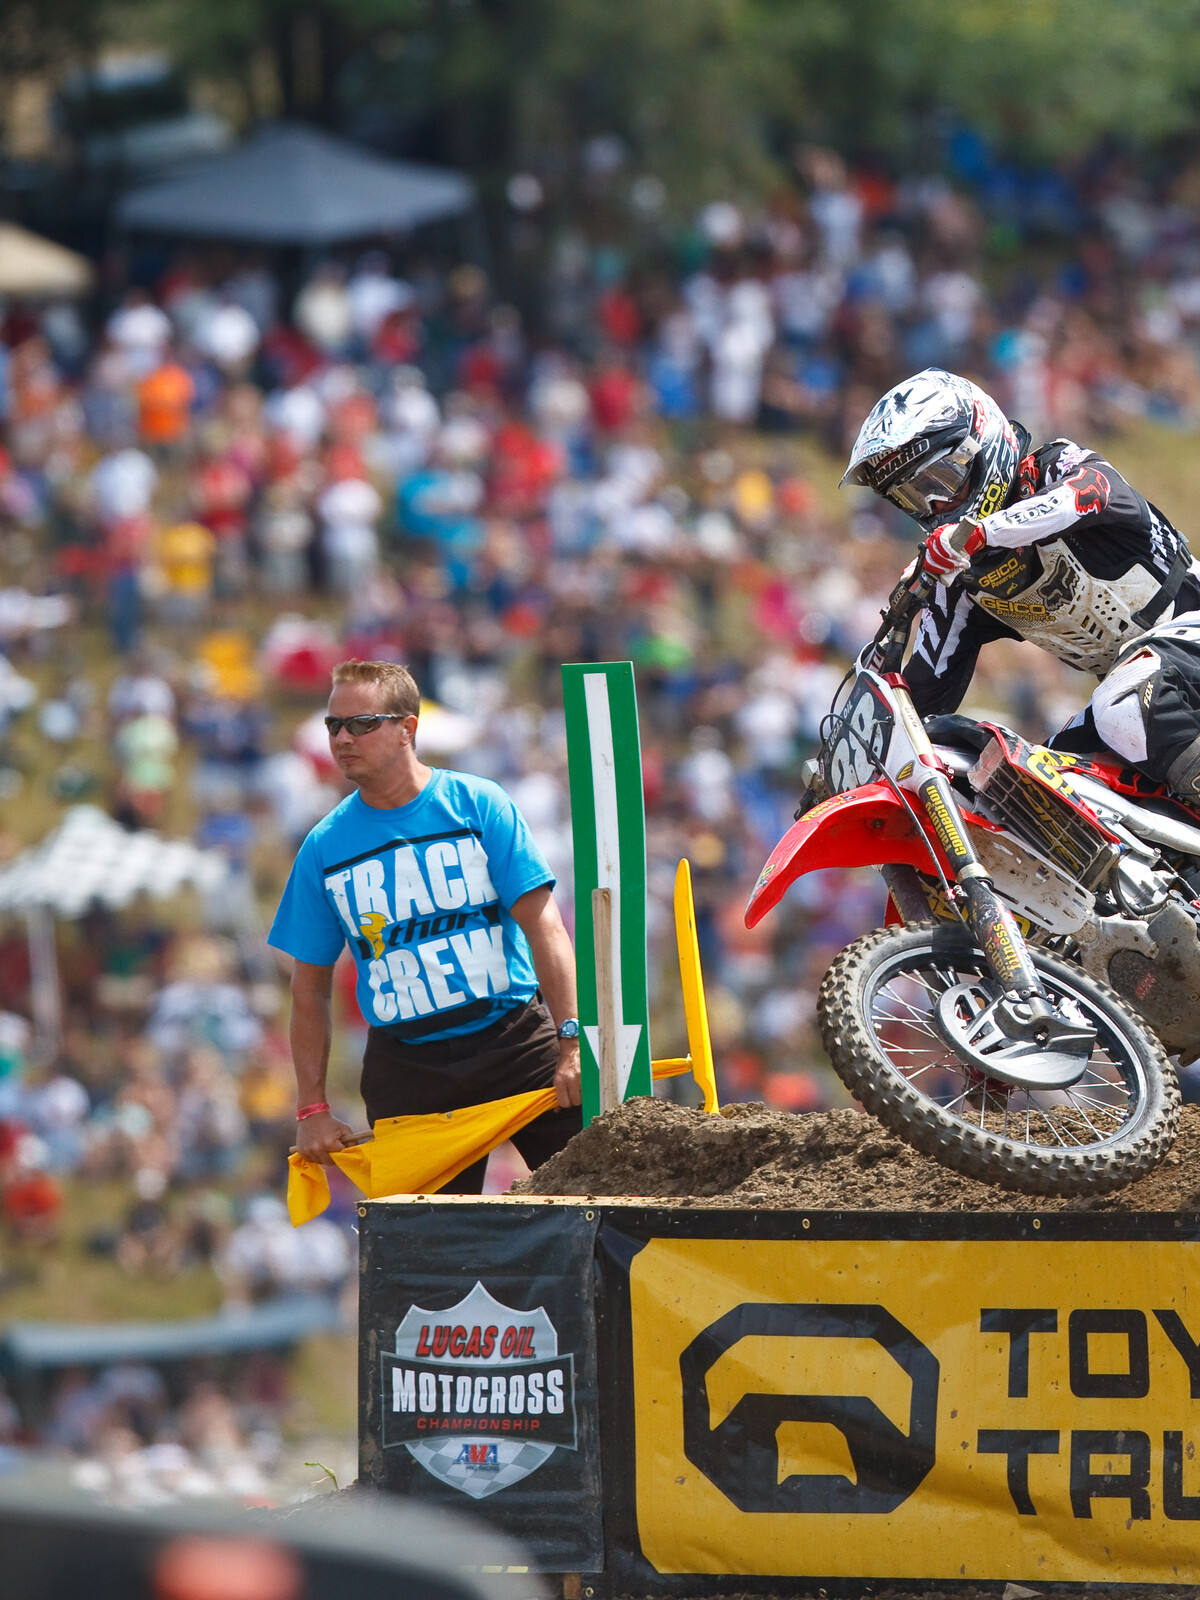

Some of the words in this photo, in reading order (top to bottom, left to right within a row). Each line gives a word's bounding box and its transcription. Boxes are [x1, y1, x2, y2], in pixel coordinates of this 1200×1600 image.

[978, 557, 1018, 588] GEICO
[991, 563, 1026, 589] Powersports
[981, 597, 1046, 615] GEICO
[1143, 681, 1153, 708] FOX
[324, 837, 499, 938] TRACK
[388, 911, 480, 946] thor
[368, 925, 511, 1022] CREW
[415, 1325, 498, 1358] LUCAS
[499, 1325, 535, 1358] OIL
[392, 1367, 564, 1414] MOTOCROSS
[417, 1418, 540, 1430] CHAMPIONSHIP
[453, 1443, 499, 1465] AMA
